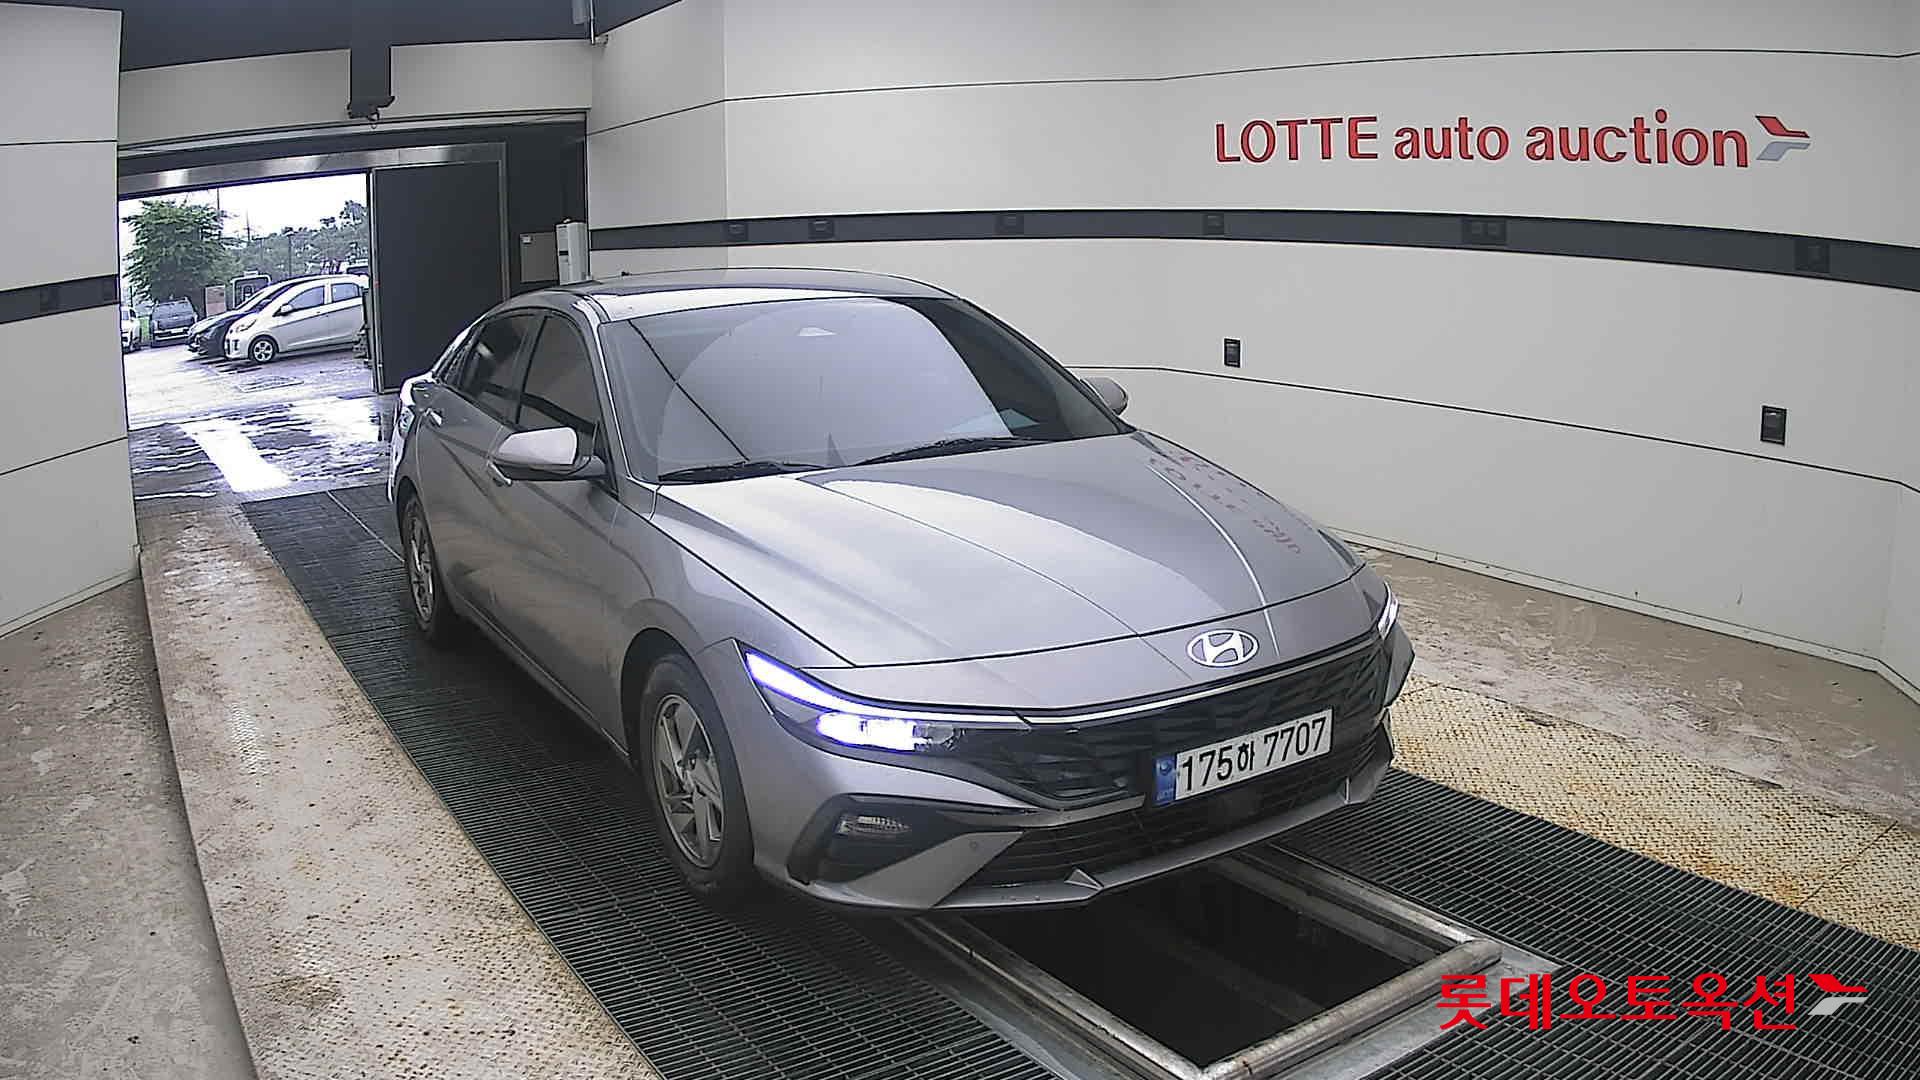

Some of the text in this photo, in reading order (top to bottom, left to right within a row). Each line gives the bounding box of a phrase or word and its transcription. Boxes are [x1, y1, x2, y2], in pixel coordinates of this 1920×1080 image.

[1215, 109, 1750, 168] LOTTE auto auction
[1182, 716, 1327, 791] 175하 7707
